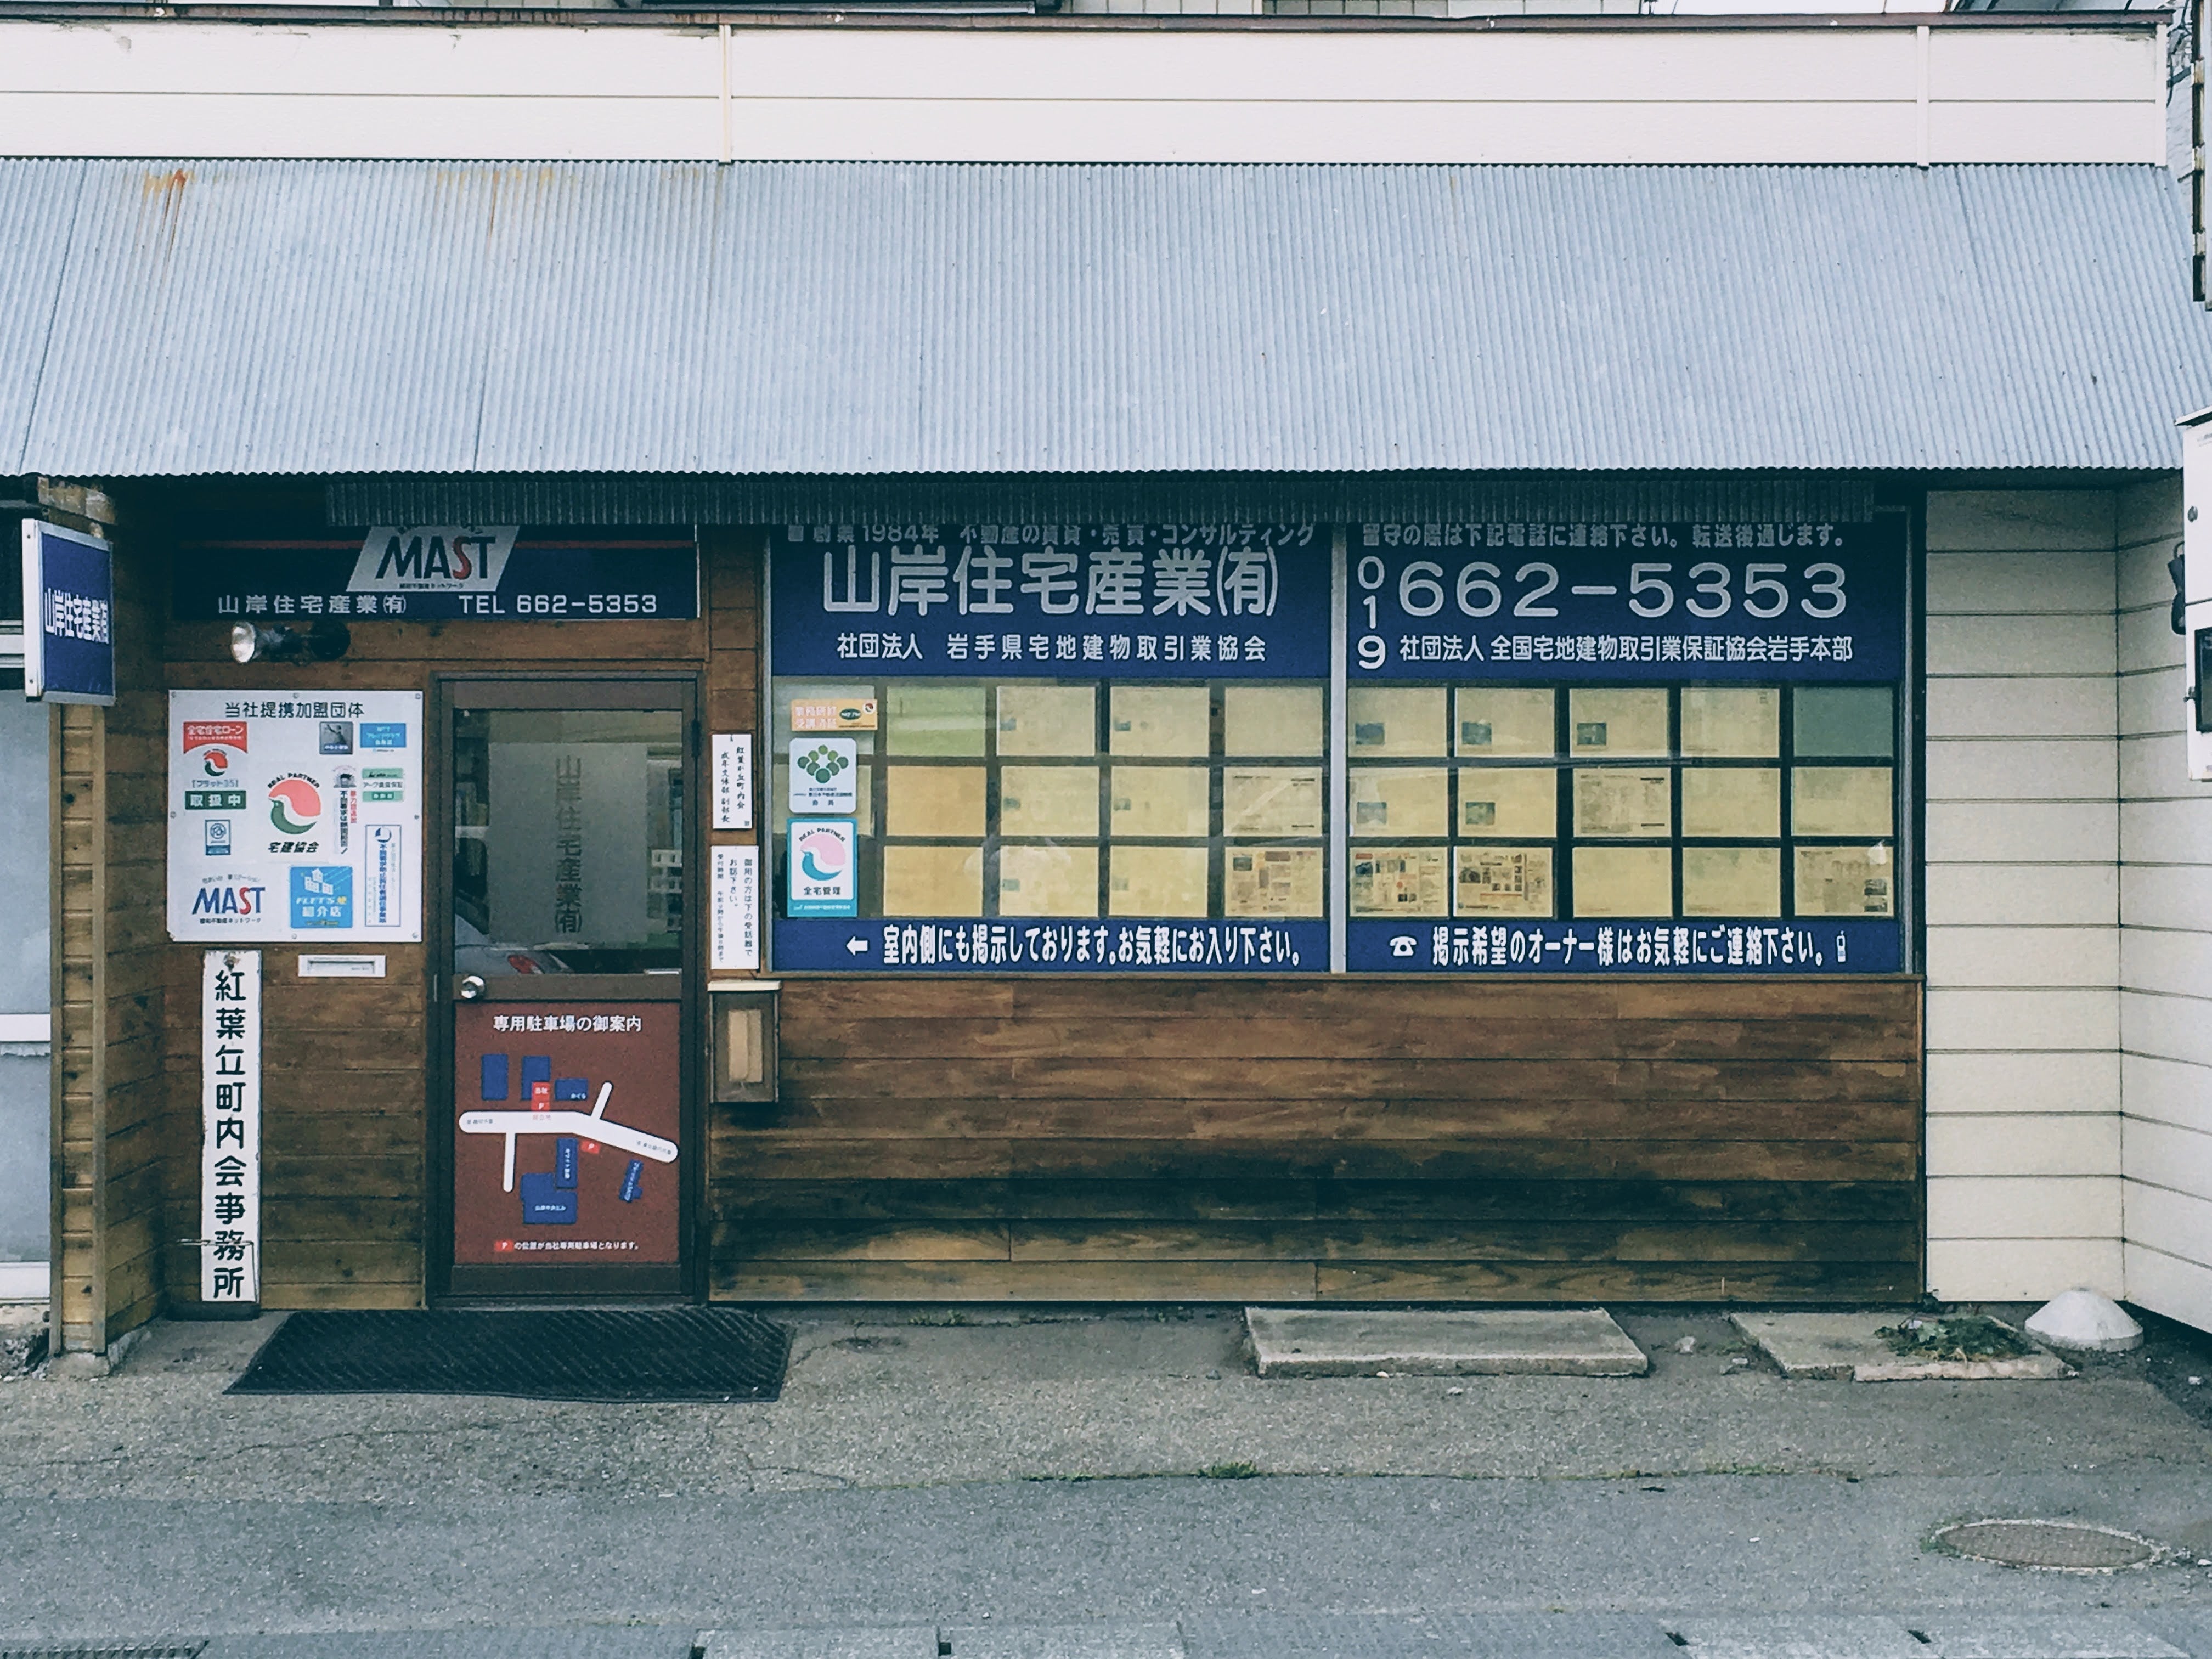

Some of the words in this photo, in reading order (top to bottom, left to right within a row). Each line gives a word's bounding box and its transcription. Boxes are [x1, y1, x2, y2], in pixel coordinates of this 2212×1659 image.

[375, 536, 495, 580] MAST
[459, 595, 505, 613] TEL
[517, 595, 656, 613] 662-5353
[837, 633, 923, 659] 社団法人
[947, 633, 1266, 662] 岩手県宅地建物取引業協会
[225, 702, 364, 718] 当社提携加盟団体
[192, 887, 266, 915] MAST
[804, 886, 841, 895] 全宅管理
[1433, 924, 1822, 966] 掲示希望のオーナー様はお気軽にご連絡下さい。
[493, 1015, 642, 1032] 専用駐車場の御案内
